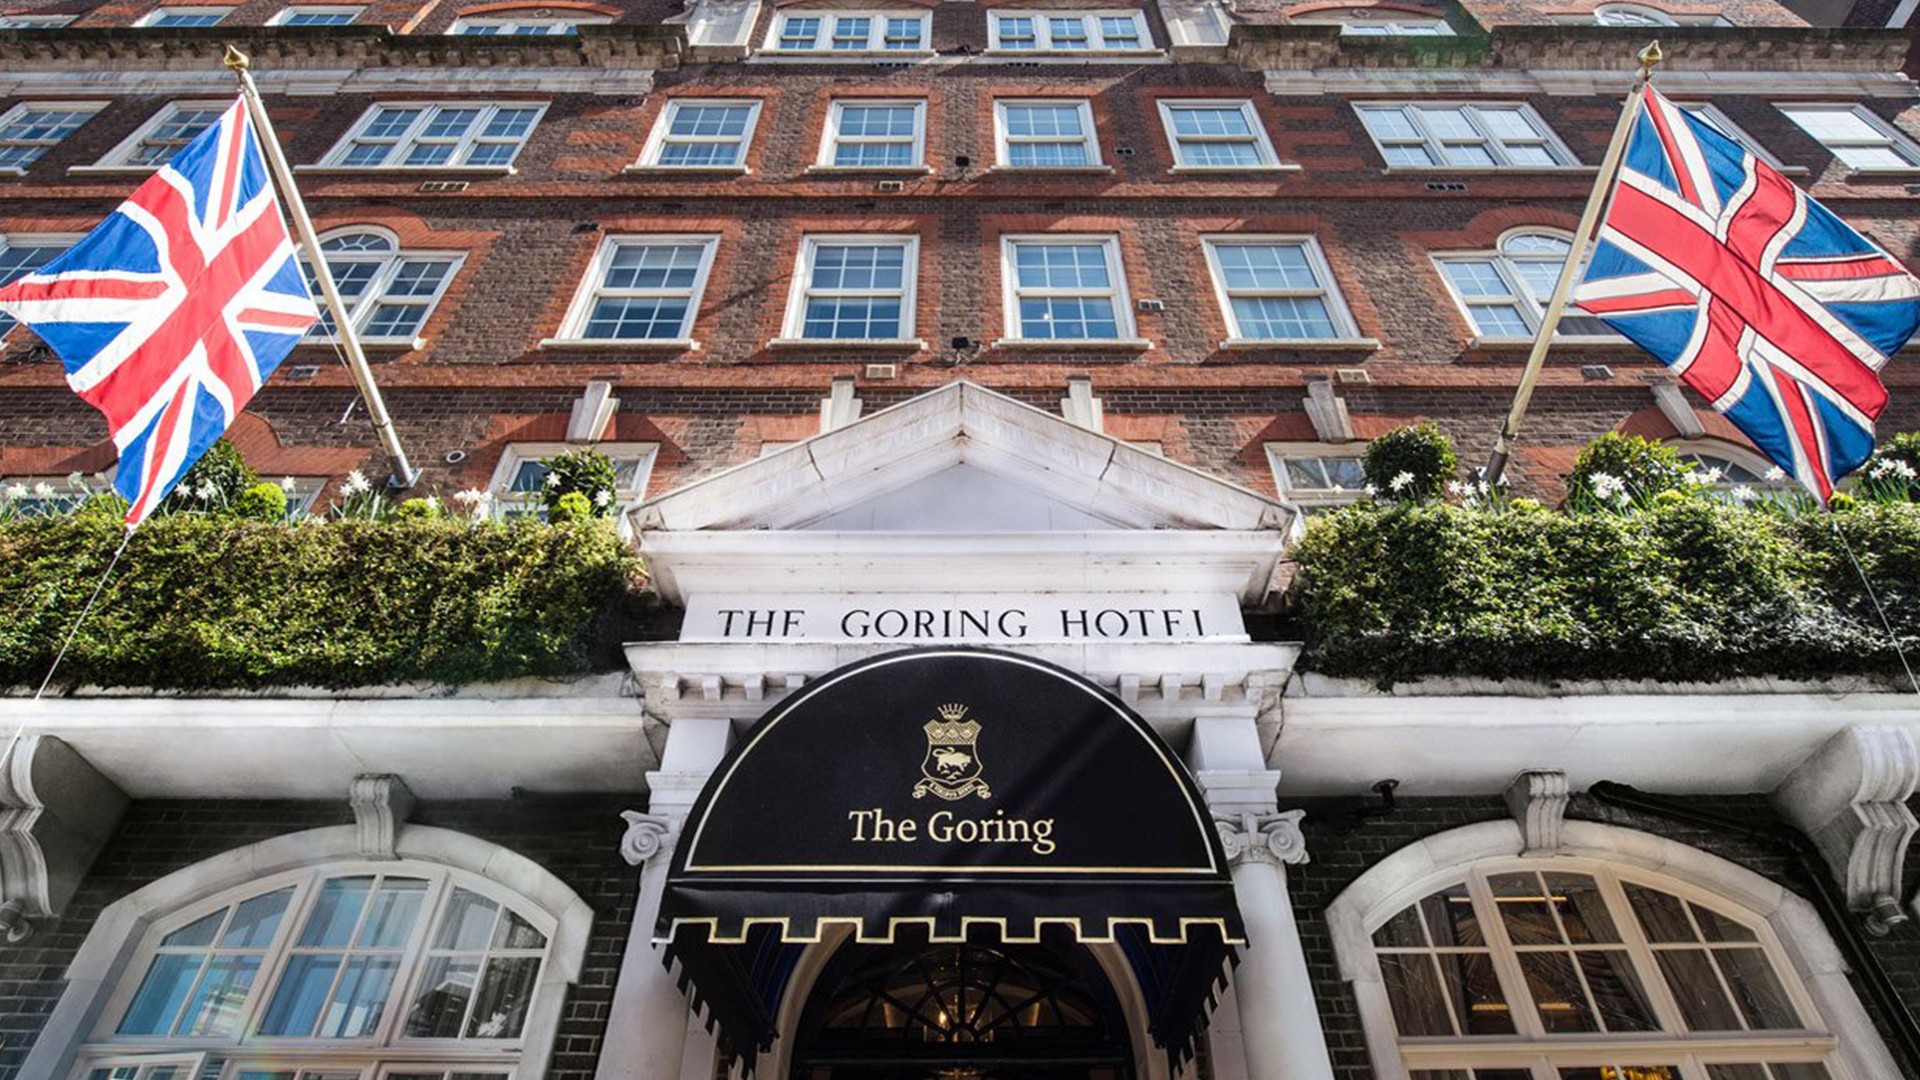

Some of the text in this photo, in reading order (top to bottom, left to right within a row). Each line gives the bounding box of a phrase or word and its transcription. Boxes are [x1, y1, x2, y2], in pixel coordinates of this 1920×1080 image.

[717, 609, 806, 637] THE
[840, 609, 1028, 638] GORING
[848, 808, 1057, 855] The Goring
